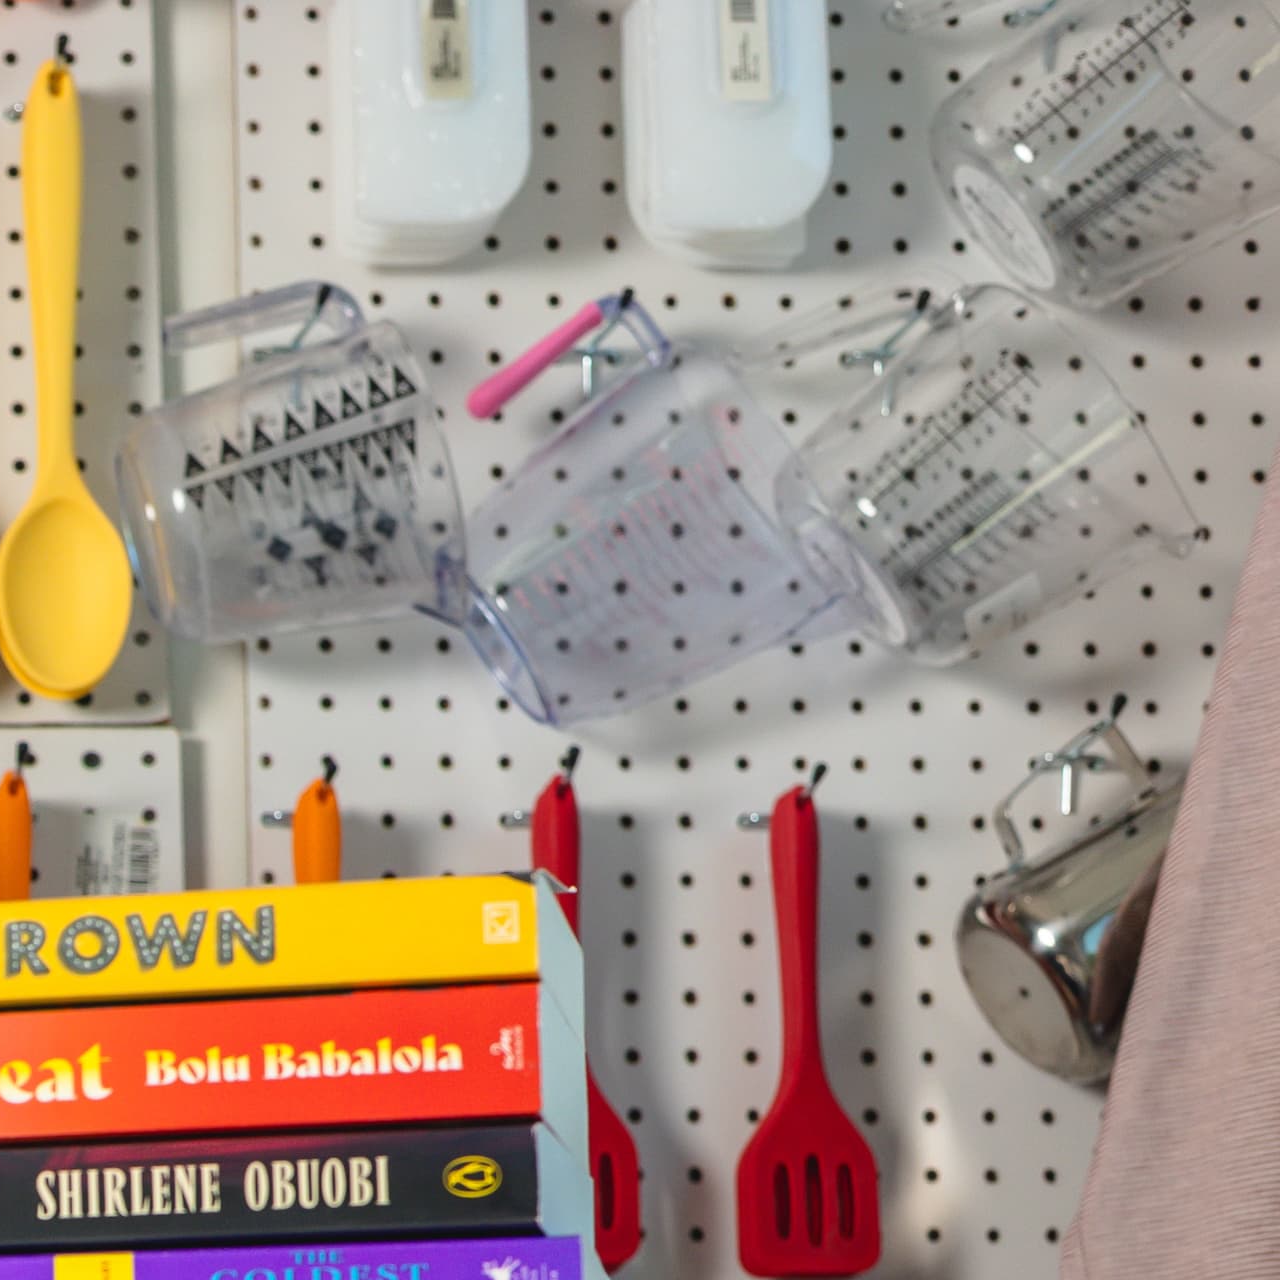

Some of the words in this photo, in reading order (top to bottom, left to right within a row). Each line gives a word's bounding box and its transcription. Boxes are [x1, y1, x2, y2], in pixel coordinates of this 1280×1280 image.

[144, 1047, 251, 1088] Bolu
[262, 1035, 463, 1081] Babalola
[35, 1163, 221, 1220] SHIRLENE
[243, 1156, 390, 1212] OBUOBI
